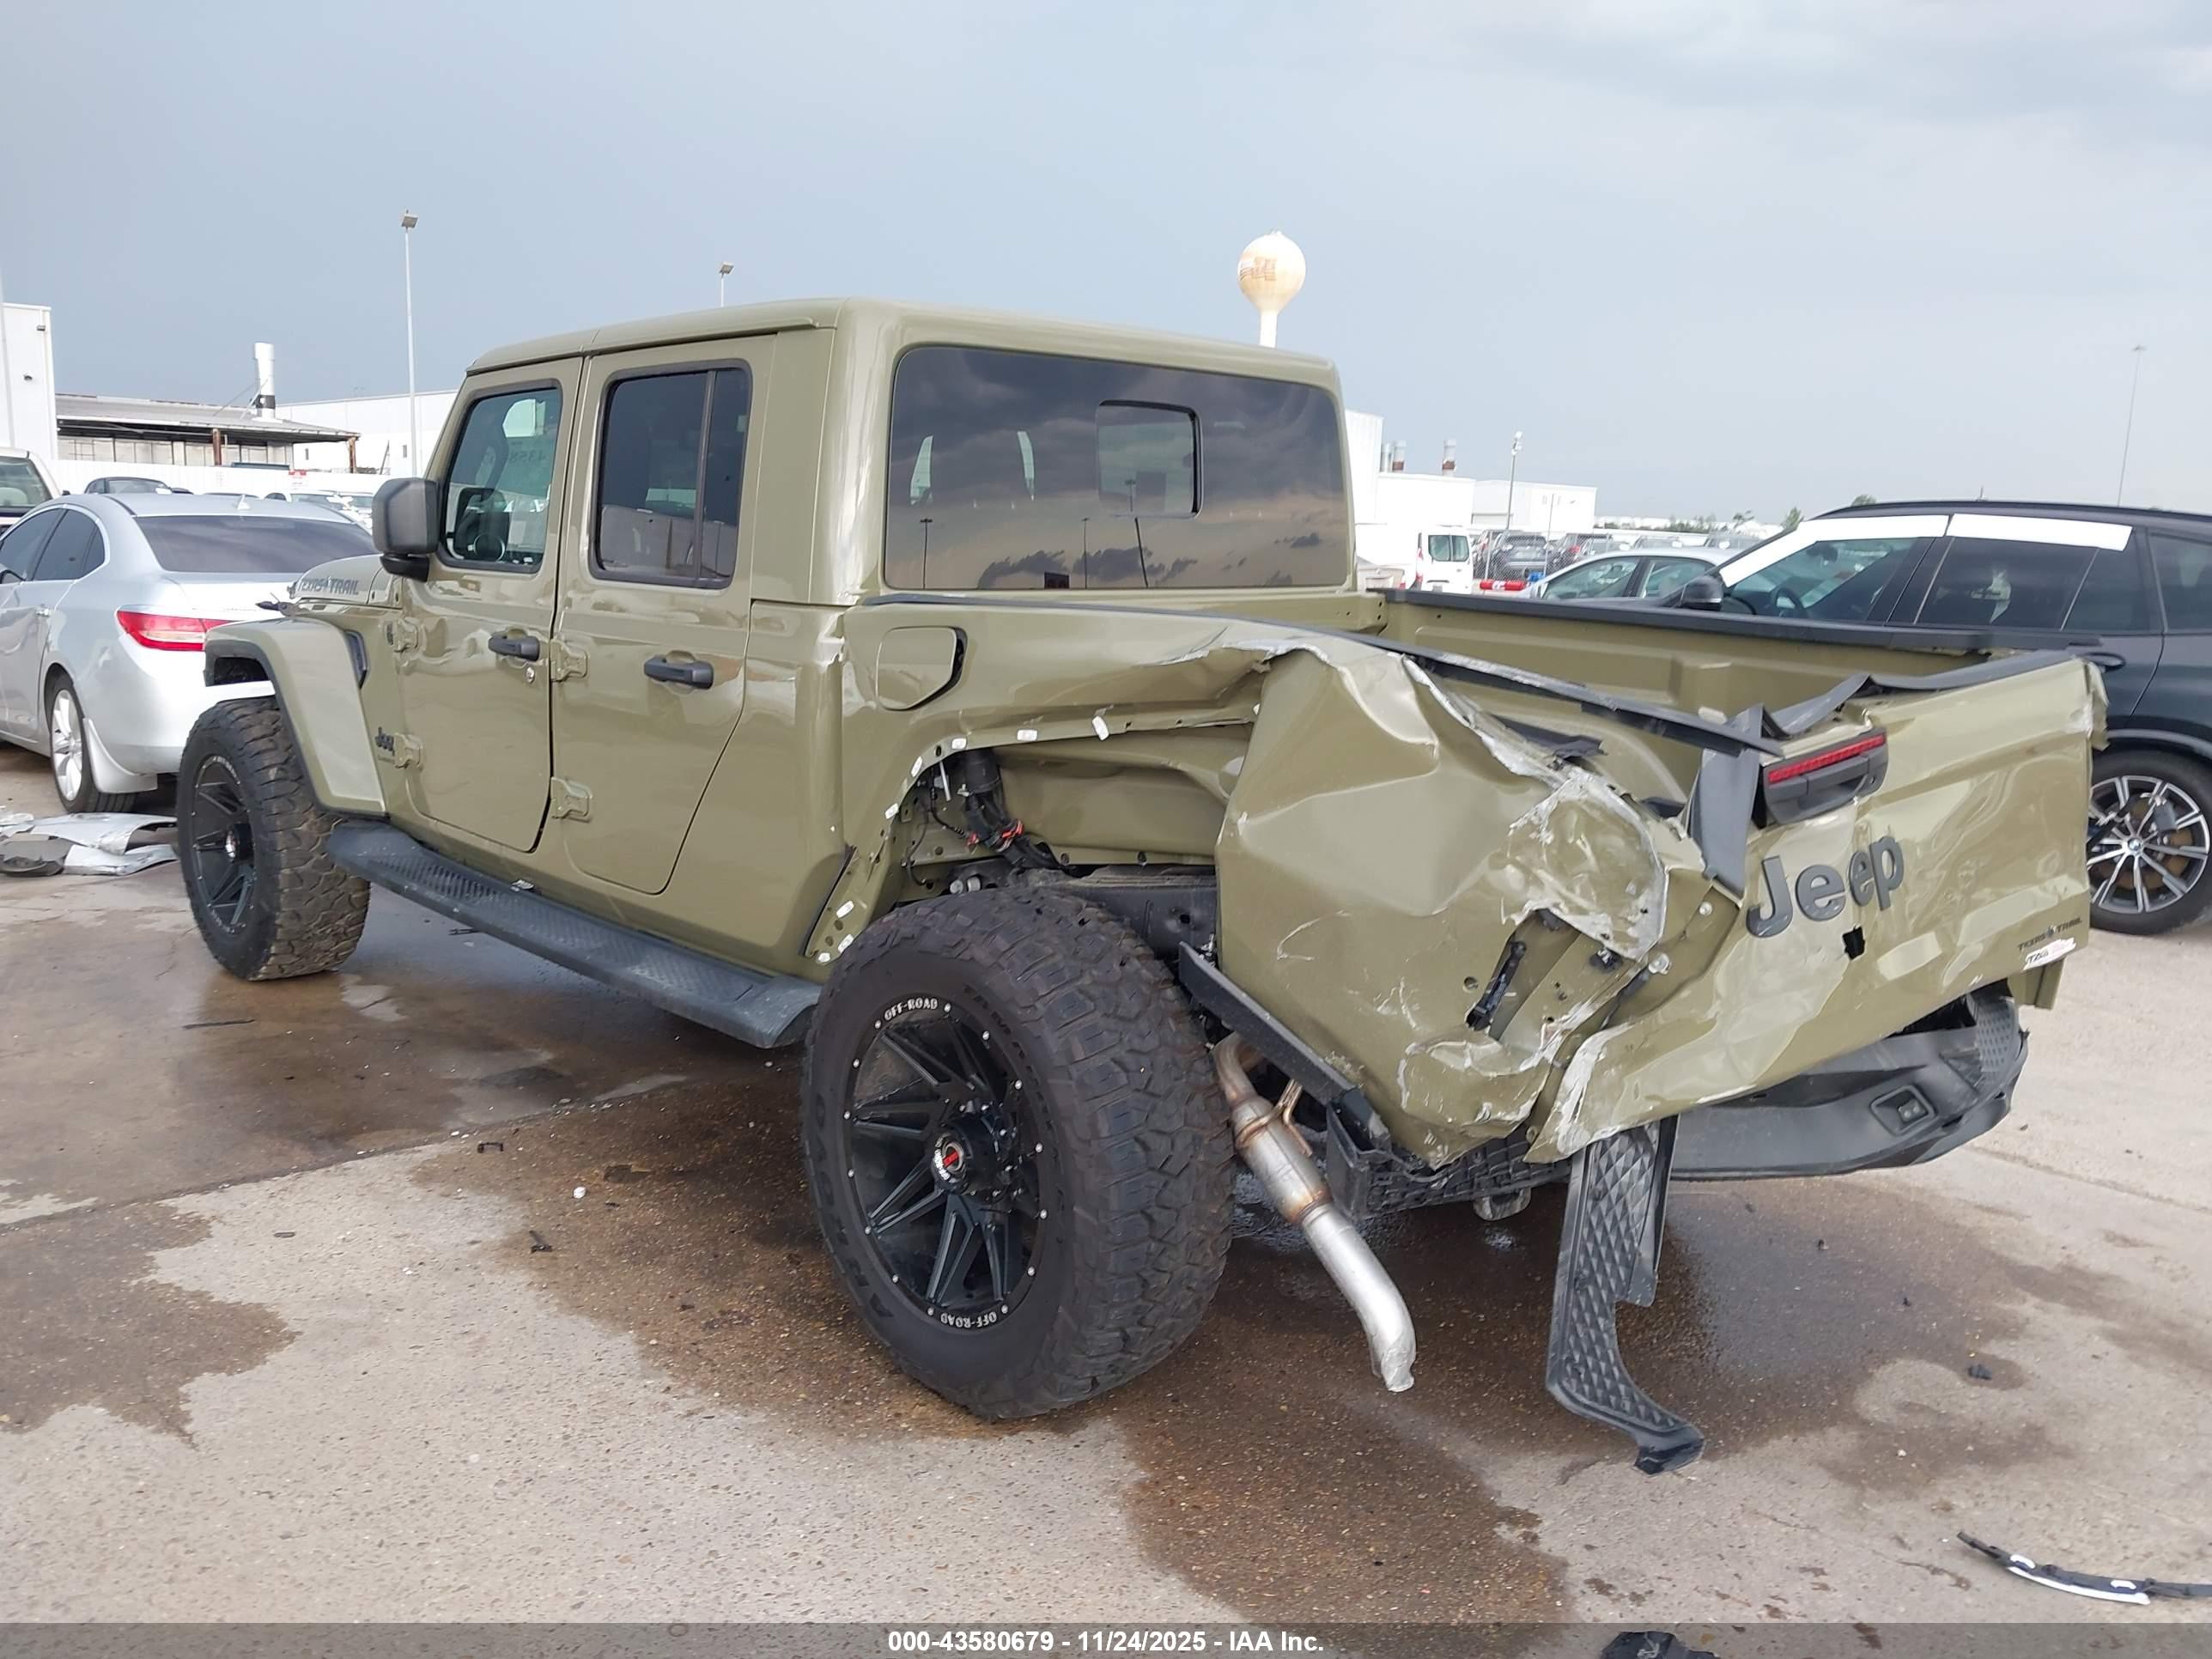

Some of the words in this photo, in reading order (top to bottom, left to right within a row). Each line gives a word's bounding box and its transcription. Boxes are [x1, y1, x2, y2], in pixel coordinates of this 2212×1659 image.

[330, 578, 359, 596] TRAIL
[1745, 836, 1905, 939] Jeep
[884, 997, 939, 1021] OFF-ROAD
[940, 1310, 997, 1328] OFF-ROAD
